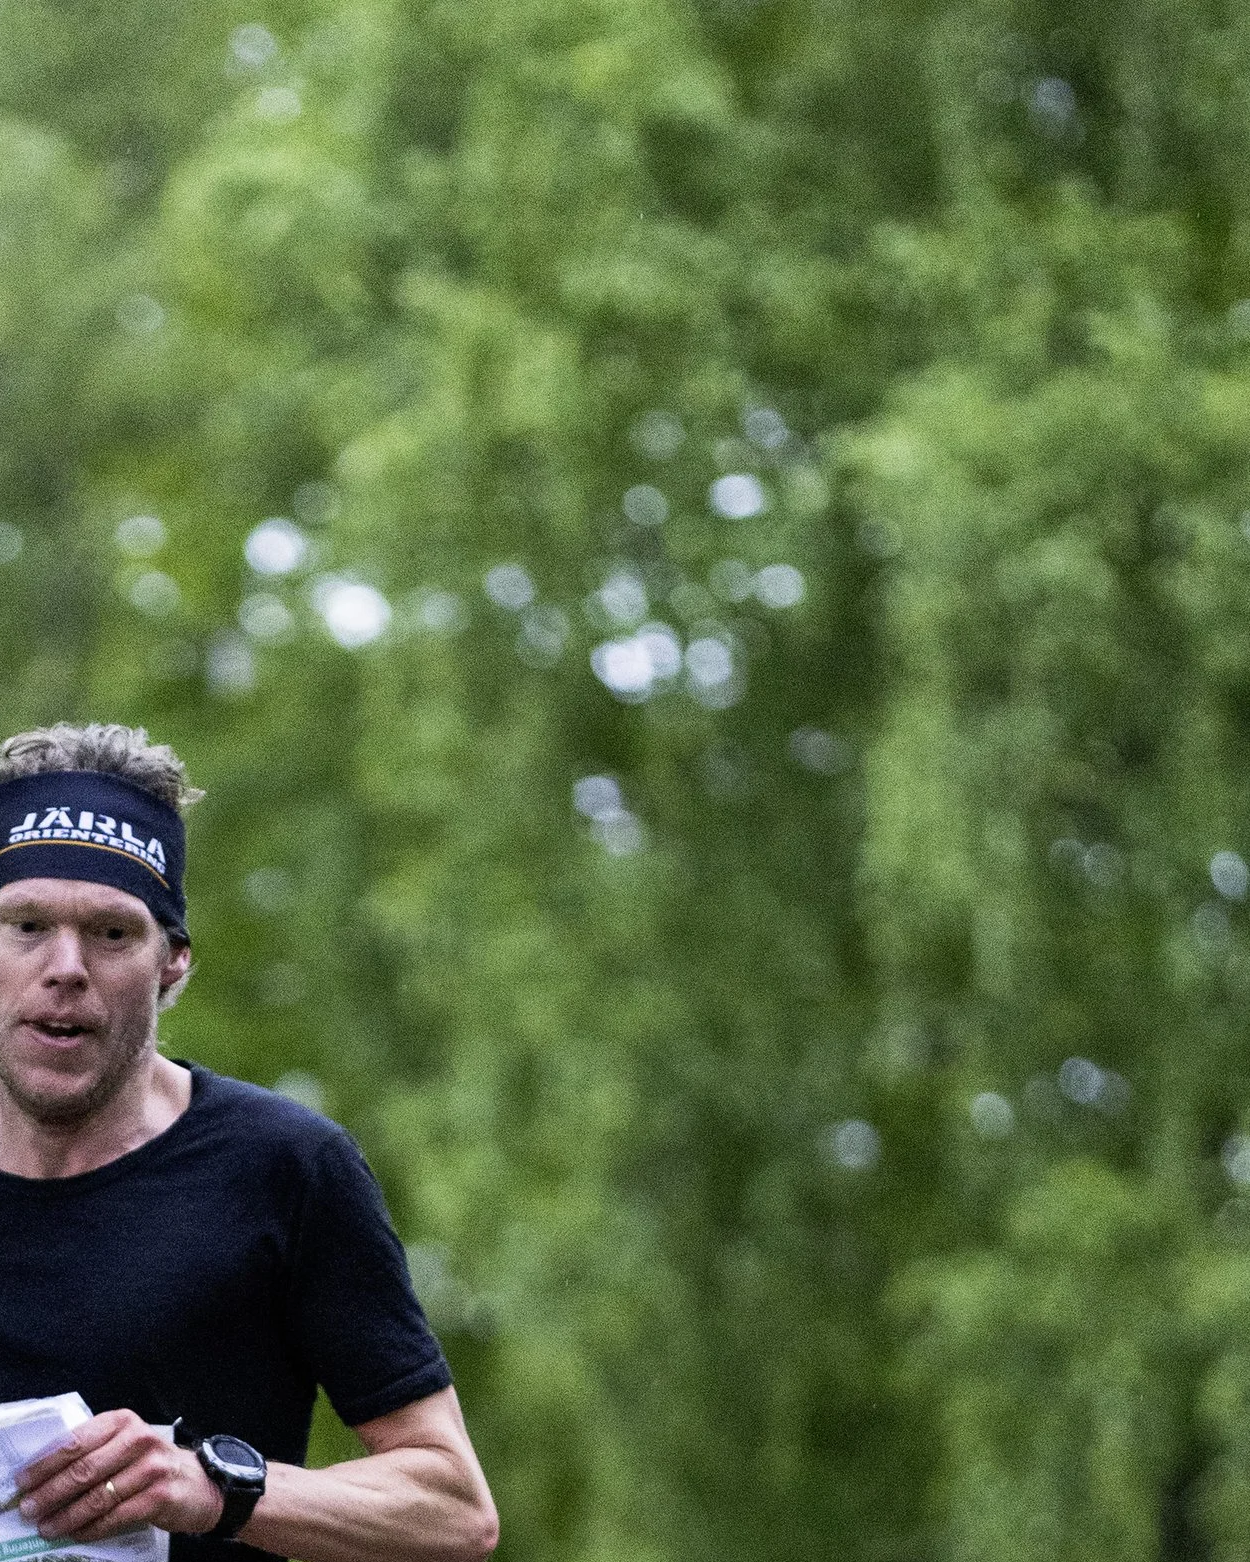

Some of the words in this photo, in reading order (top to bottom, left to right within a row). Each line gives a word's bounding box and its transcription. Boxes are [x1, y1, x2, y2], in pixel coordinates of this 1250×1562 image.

[9, 828, 166, 874] ORIENTERING
[10, 807, 166, 864] JÄRLA
[2, 1539, 47, 1556] entering
